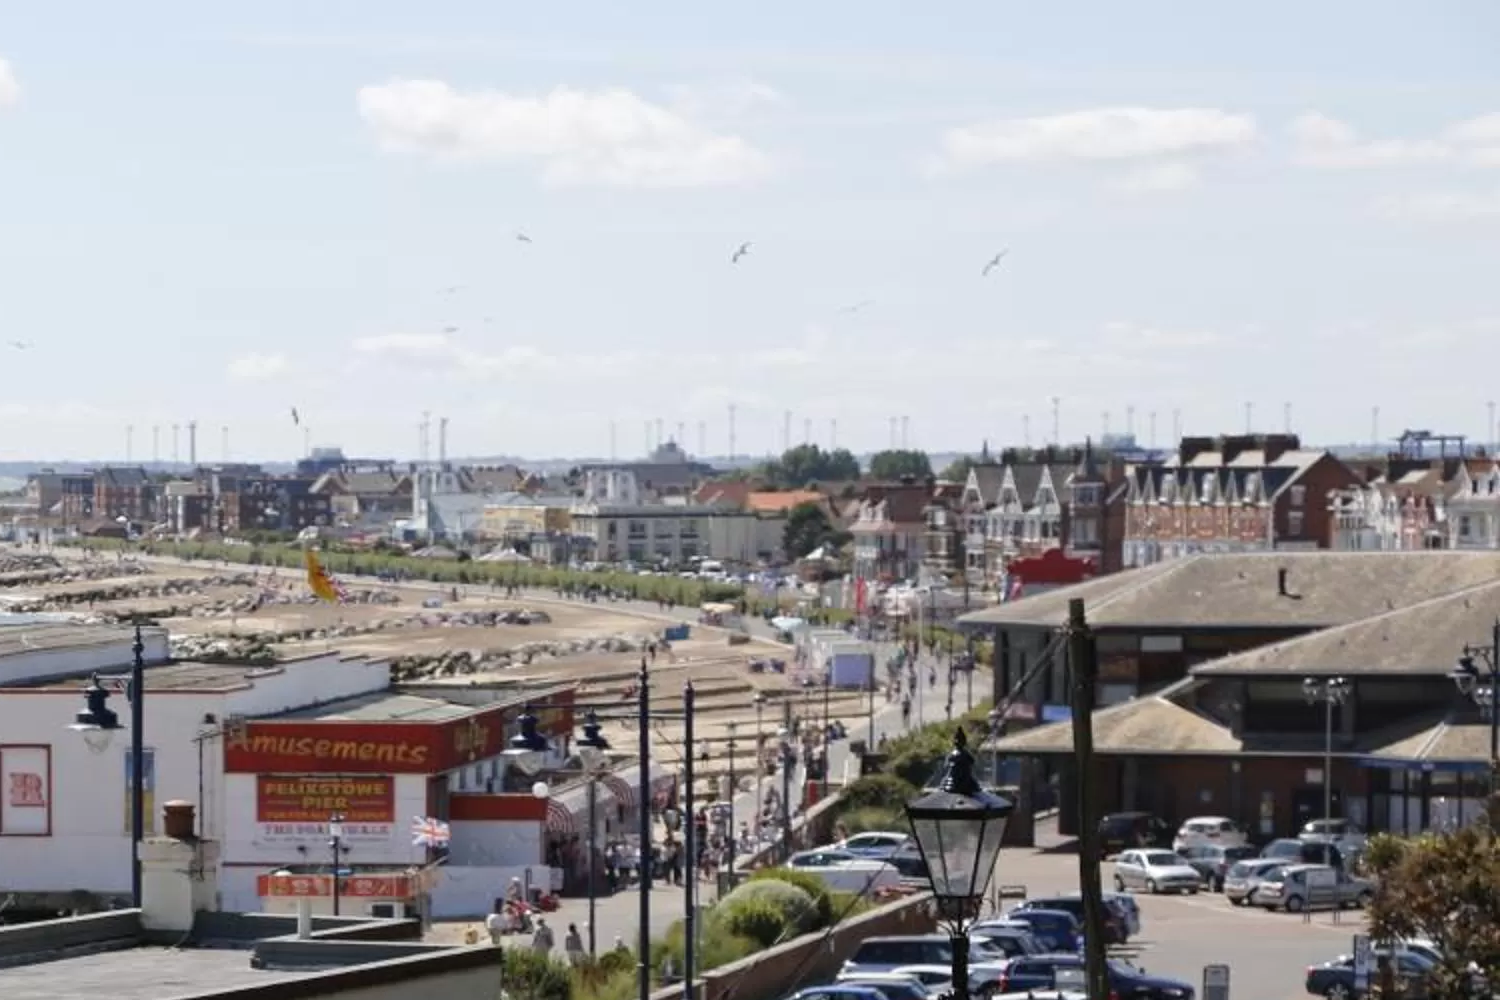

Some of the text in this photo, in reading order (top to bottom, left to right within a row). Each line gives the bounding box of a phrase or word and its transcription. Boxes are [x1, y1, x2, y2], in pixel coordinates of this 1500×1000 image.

[228, 725, 429, 765] Amusements
[265, 783, 385, 796] FELIXSTOWE
[302, 797, 348, 809] PIER
